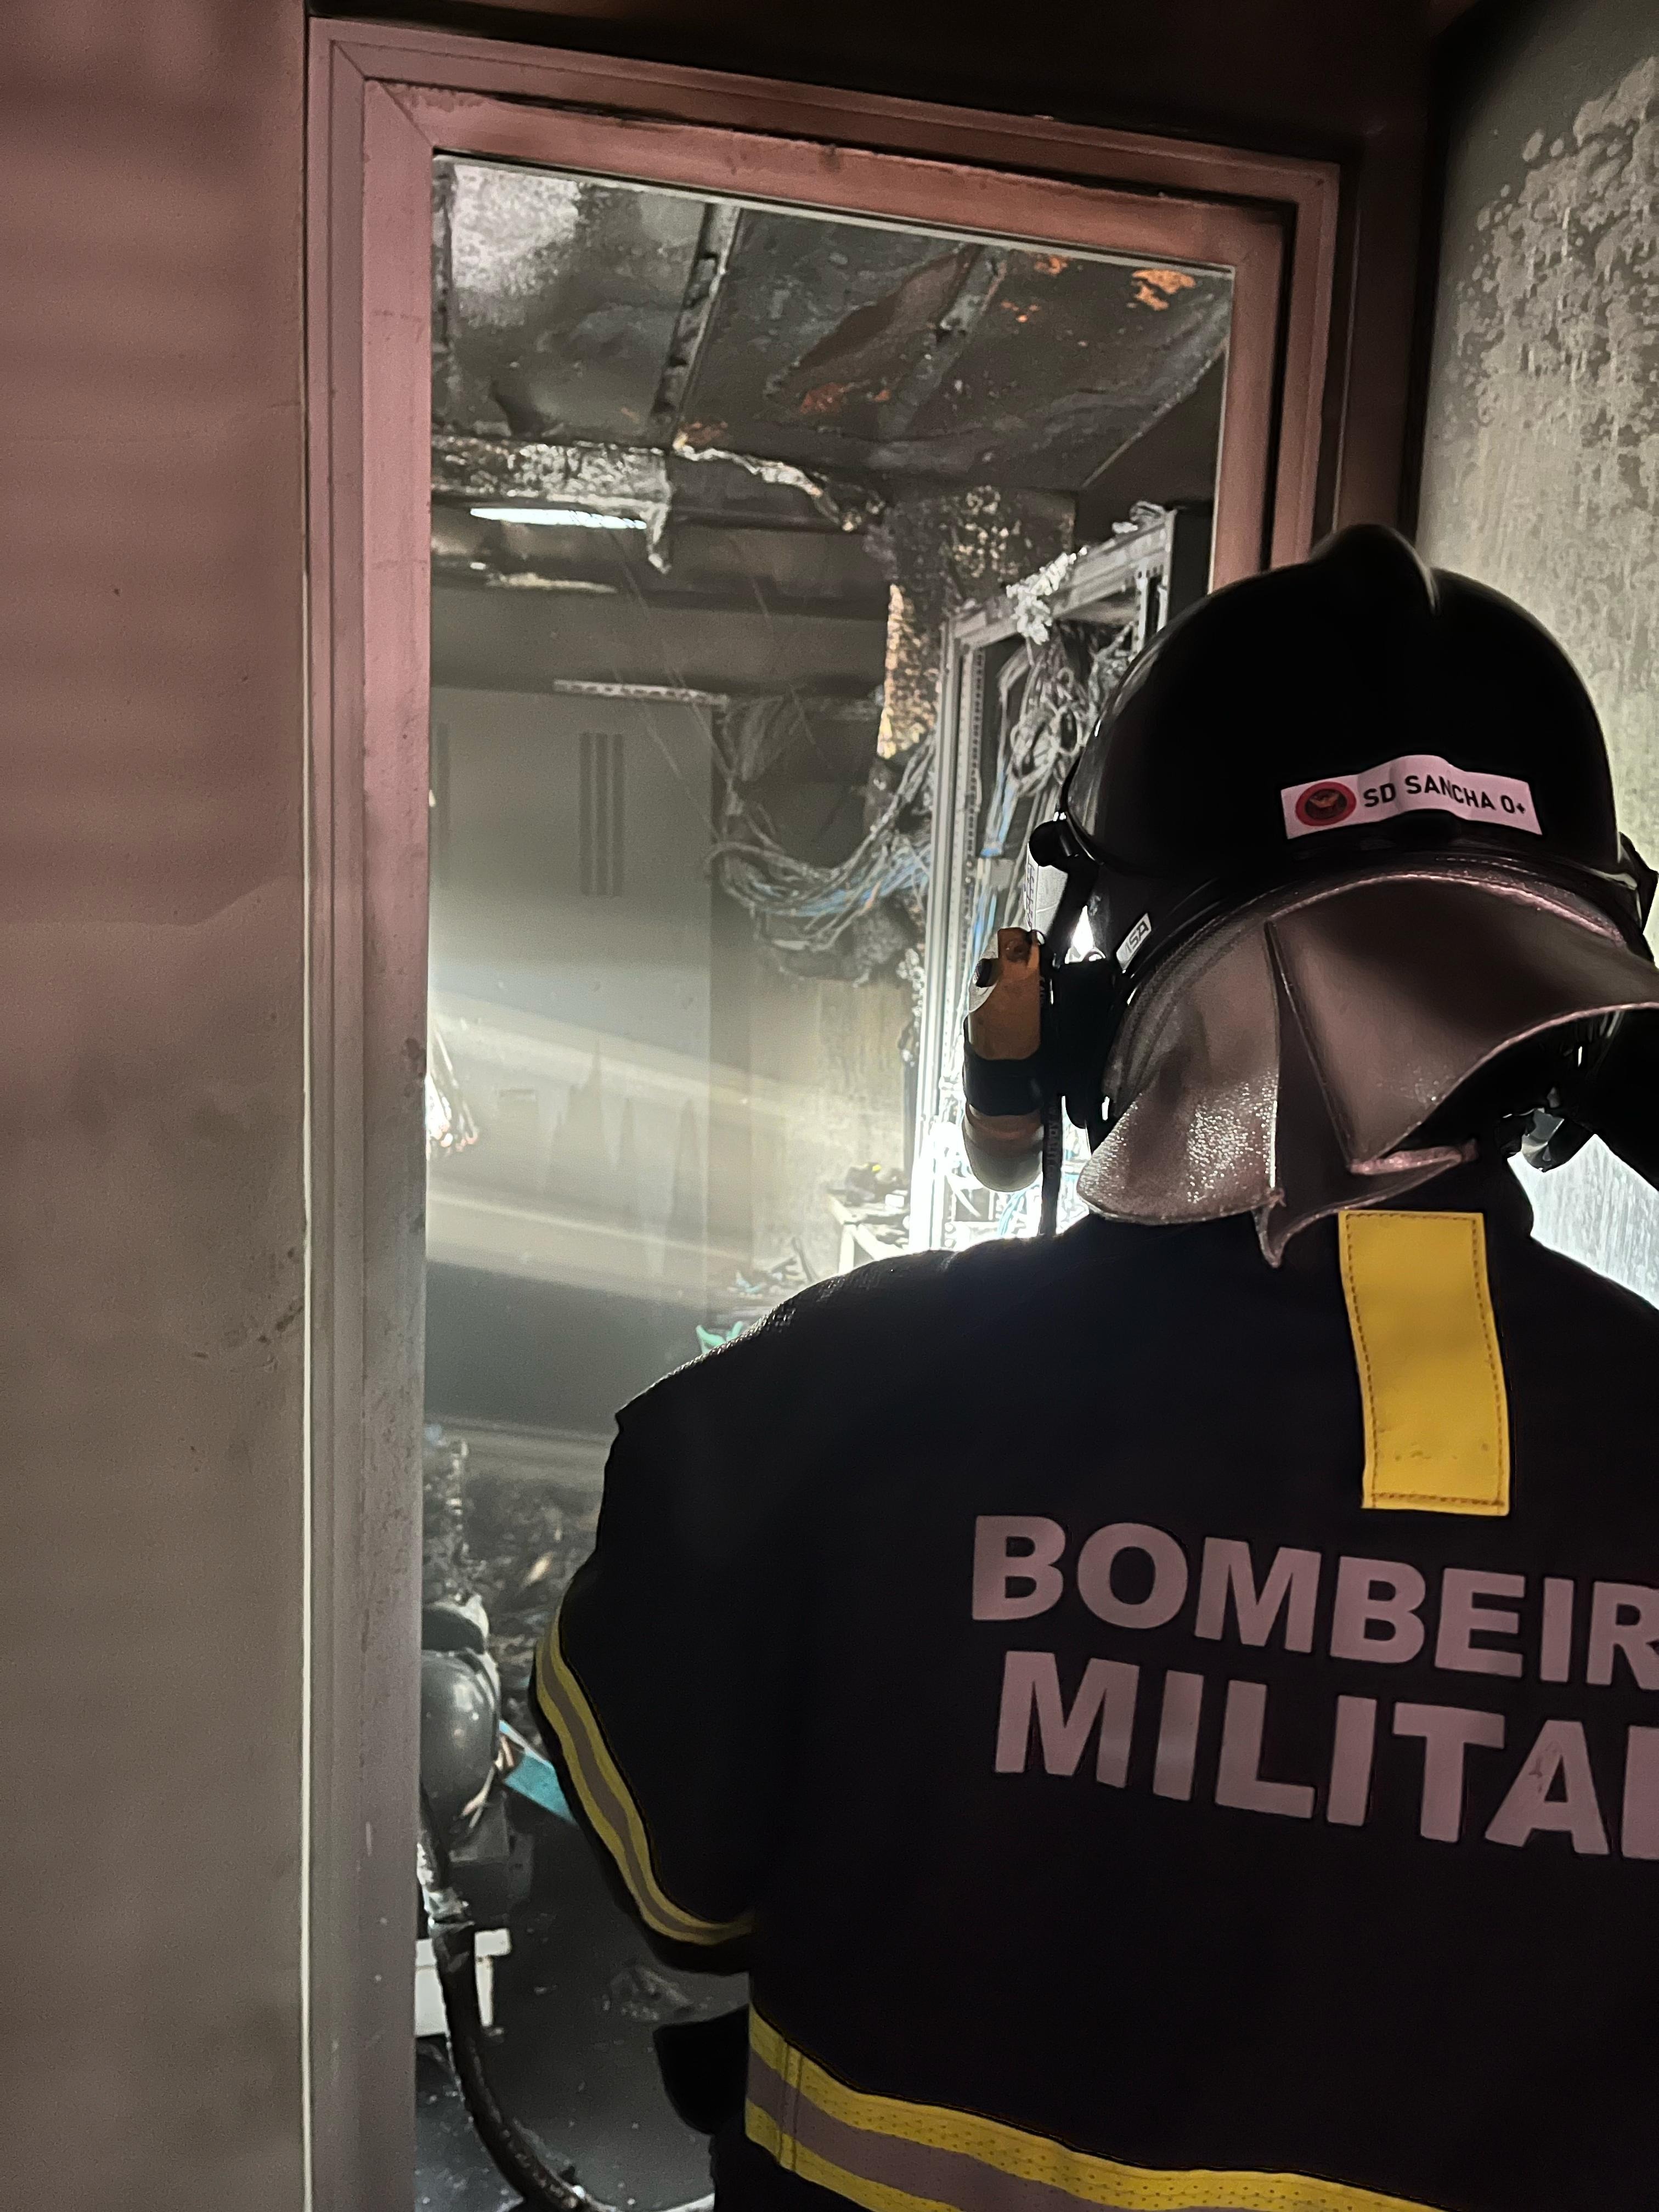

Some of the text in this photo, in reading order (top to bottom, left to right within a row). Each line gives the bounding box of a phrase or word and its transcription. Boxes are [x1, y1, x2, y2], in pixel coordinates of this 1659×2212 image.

[1363, 782, 1397, 808] SD
[1404, 775, 1497, 810] SANCHA
[972, 1516, 1659, 1690] BOMBEIR
